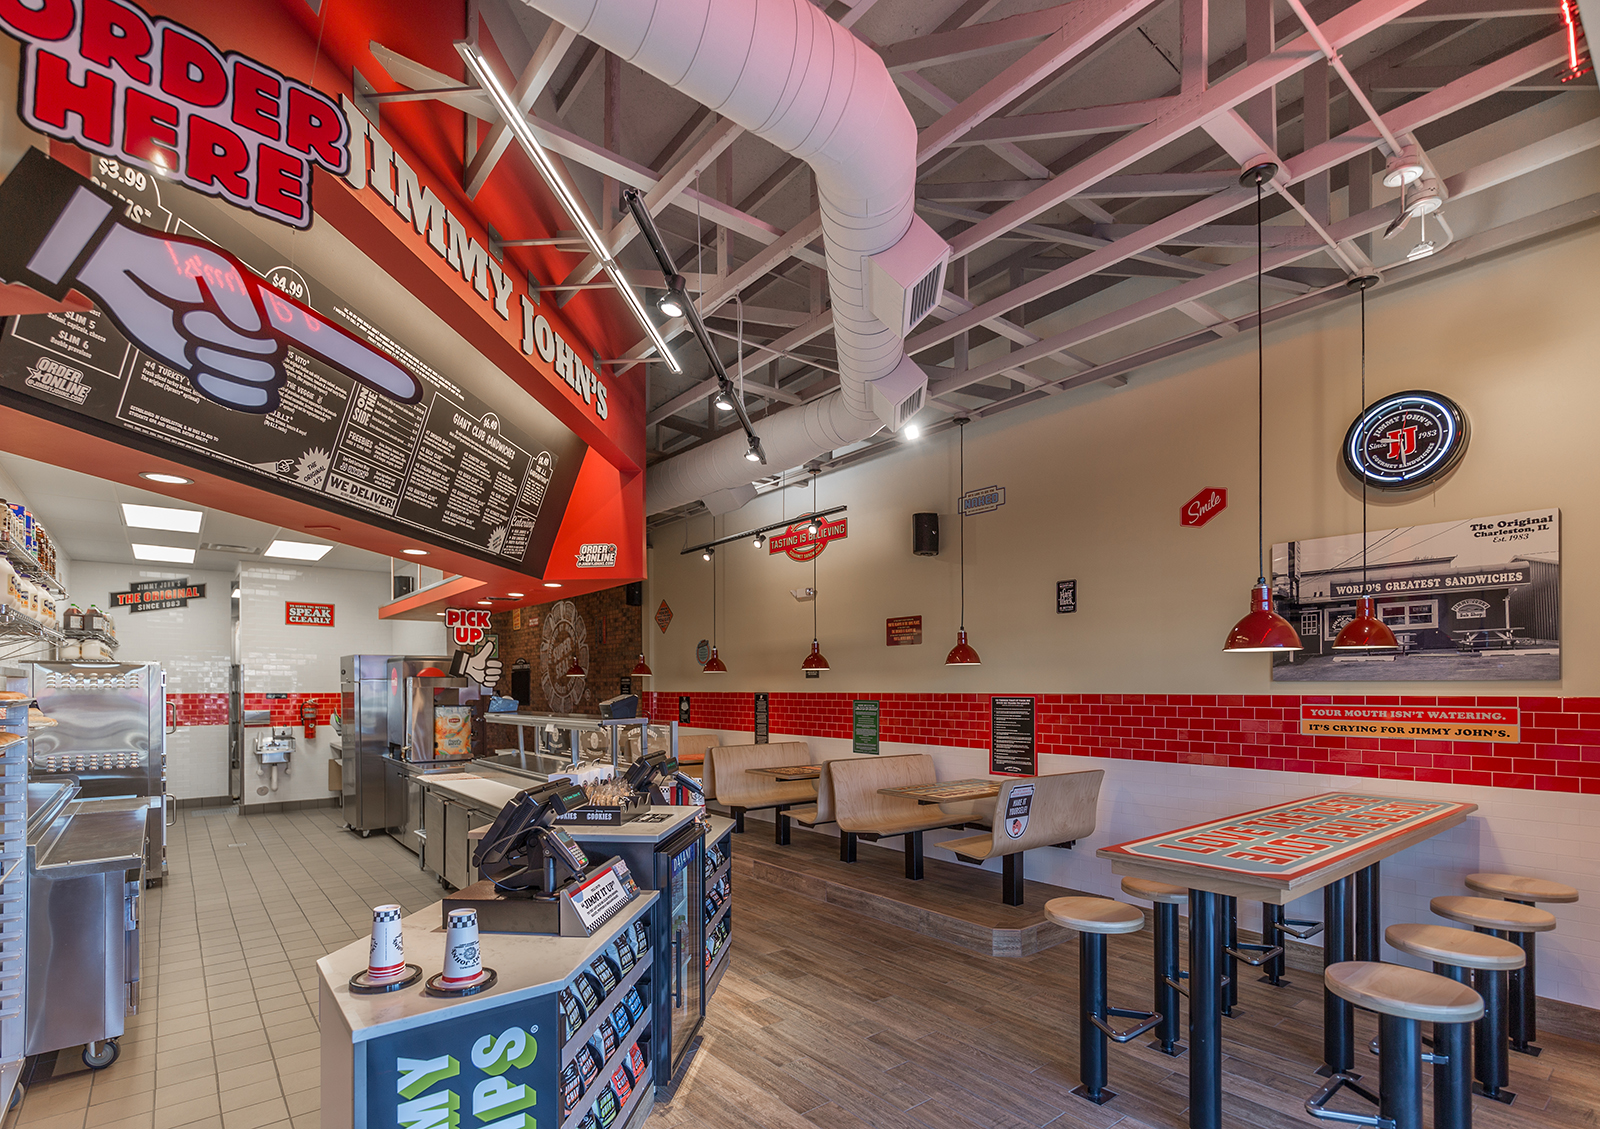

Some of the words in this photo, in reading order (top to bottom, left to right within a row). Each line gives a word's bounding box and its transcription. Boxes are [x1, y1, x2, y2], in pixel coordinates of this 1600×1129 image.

[34, 49, 305, 219] HERE
[98, 157, 147, 192] $3.99
[342, 93, 513, 321] JIMMY
[520, 294, 608, 420] JOHN'S
[272, 273, 303, 298] $4.99
[89, 320, 96, 329] 5
[58, 330, 82, 347] SLIM
[82, 341, 89, 350] 6
[38, 358, 82, 382] ORDER
[145, 361, 156, 370] #4
[159, 366, 185, 382] TURKEY
[42, 374, 90, 397] ONLINE
[357, 387, 370, 408] ON
[364, 391, 378, 413] THE
[352, 407, 371, 427] SIDE
[1373, 416, 1400, 438] JIMMY
[1402, 414, 1434, 427] JOHN'S
[453, 412, 472, 432] GIANT
[471, 425, 486, 441] CLUB
[485, 434, 516, 460] SANDWICHES
[1368, 443, 1388, 451] Since
[1418, 429, 1438, 440] 1983
[1372, 454, 1398, 469] GOURMET
[1399, 442, 1435, 469] SANDWICHES
[330, 476, 348, 491] WE
[350, 483, 395, 509] DELIVER!
[964, 492, 999, 509] NAKED
[1188, 491, 1221, 524] Smile
[1470, 523, 1494, 531] The
[1497, 514, 1554, 528] Original
[1473, 527, 1535, 538] Charleston,
[771, 535, 798, 549] TASTING
[799, 533, 807, 543] IS
[1509, 533, 1529, 542] 1983
[581, 545, 608, 554] ORDER
[586, 553, 615, 562] ONLINE
[137, 582, 158, 591] JIMMY
[160, 580, 181, 589] JOHN'S
[1385, 579, 1441, 591] GREATEST
[1445, 572, 1523, 587] SANDWICHES
[117, 593, 141, 605] THE
[143, 587, 199, 602] ORIGINAL
[137, 603, 160, 611] SINCE
[162, 601, 180, 609] 1983
[289, 607, 331, 618] SPEAK
[289, 616, 331, 624] CLEARLY
[448, 611, 490, 627] PICK
[456, 628, 482, 642] UP
[1310, 709, 1342, 717] YOUR
[1344, 709, 1388, 718] MOUTH
[1390, 710, 1425, 719] ISN'T
[1427, 711, 1507, 720] WATERING.
[1308, 723, 1331, 732] IT'S
[1332, 724, 1378, 733] CRYING
[1380, 726, 1405, 734] FOR
[1408, 727, 1451, 736] JIMMY
[1454, 728, 1511, 738] JOHN'S.
[587, 812, 612, 821] COOKIES
[1343, 800, 1445, 823] TASTE
[1150, 825, 1281, 855] LOVE
[1234, 811, 1329, 830] THE
[1283, 795, 1387, 816] TASTE
[1298, 818, 1394, 838] THE
[1219, 833, 1350, 866] LOVE
[600, 887, 607, 897] IT
